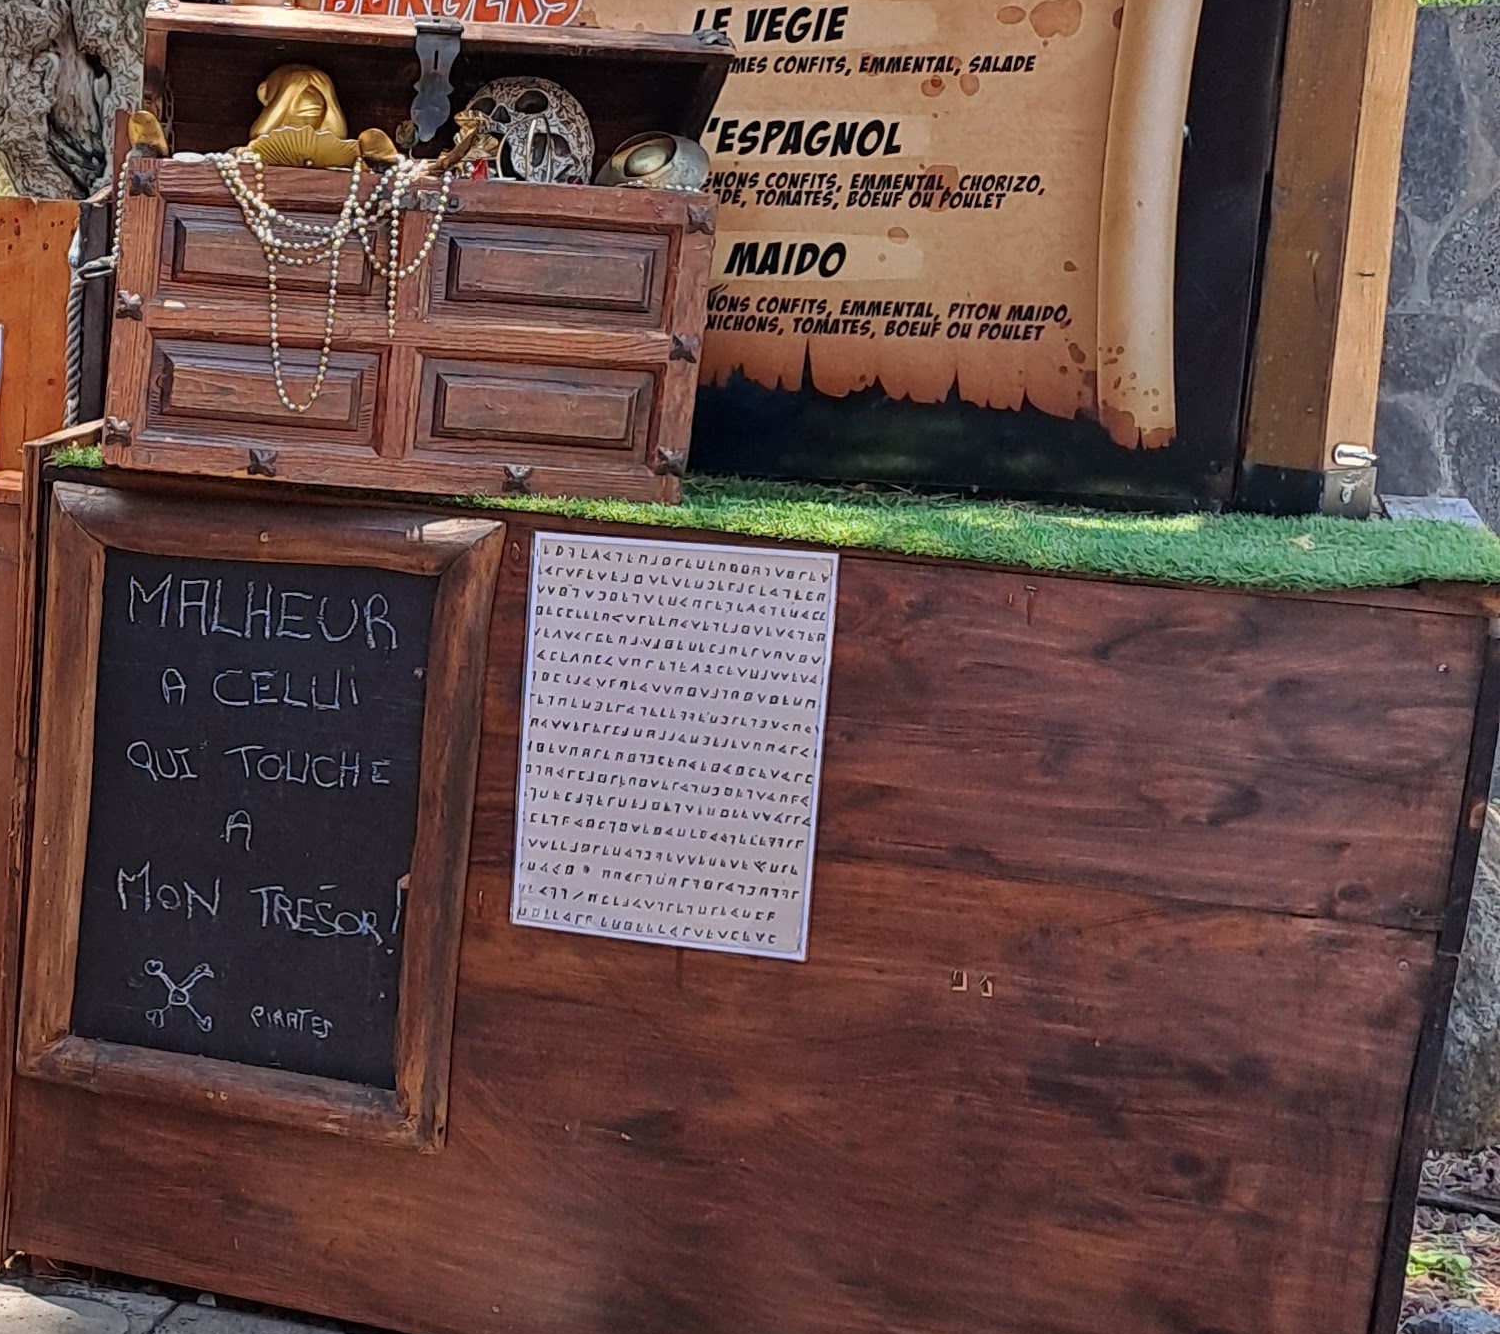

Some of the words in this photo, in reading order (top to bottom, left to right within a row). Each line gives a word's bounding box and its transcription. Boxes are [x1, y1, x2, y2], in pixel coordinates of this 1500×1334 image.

[692, 7, 732, 38] LE
[744, 6, 848, 43] VEGIE
[773, 57, 852, 76] CONFITS,
[859, 56, 961, 76] EMMENTAL,
[968, 56, 1036, 73] SALADE
[707, 117, 902, 157] 'ESPAGNOL
[756, 190, 839, 210] TOMATES,
[846, 189, 902, 207] BOEUF
[909, 190, 932, 207] OU
[938, 192, 1006, 209] POULET
[765, 172, 842, 192] CONFITS,
[850, 173, 949, 194] EMMENTAL,
[959, 175, 1045, 196] CHORIZO,
[723, 241, 846, 278] MAIDO
[705, 314, 784, 335] NICHONS,
[793, 317, 877, 338] TOMATES,
[884, 320, 942, 337] BOEUF
[947, 322, 971, 339] OU
[977, 323, 1045, 341] POULET
[756, 297, 833, 318] CONFITS,
[841, 299, 939, 321] EMMENTAL,
[948, 302, 1000, 319] PITON
[1006, 304, 1073, 325] MAIDO,
[129, 573, 399, 649] MALHEUR
[162, 668, 187, 705] A
[213, 666, 359, 710] CELUI
[126, 740, 198, 781] QUI
[224, 745, 391, 787] TOUCHE
[225, 809, 250, 851] A
[118, 861, 221, 918] MON
[251, 1006, 332, 1038] PIRATES
